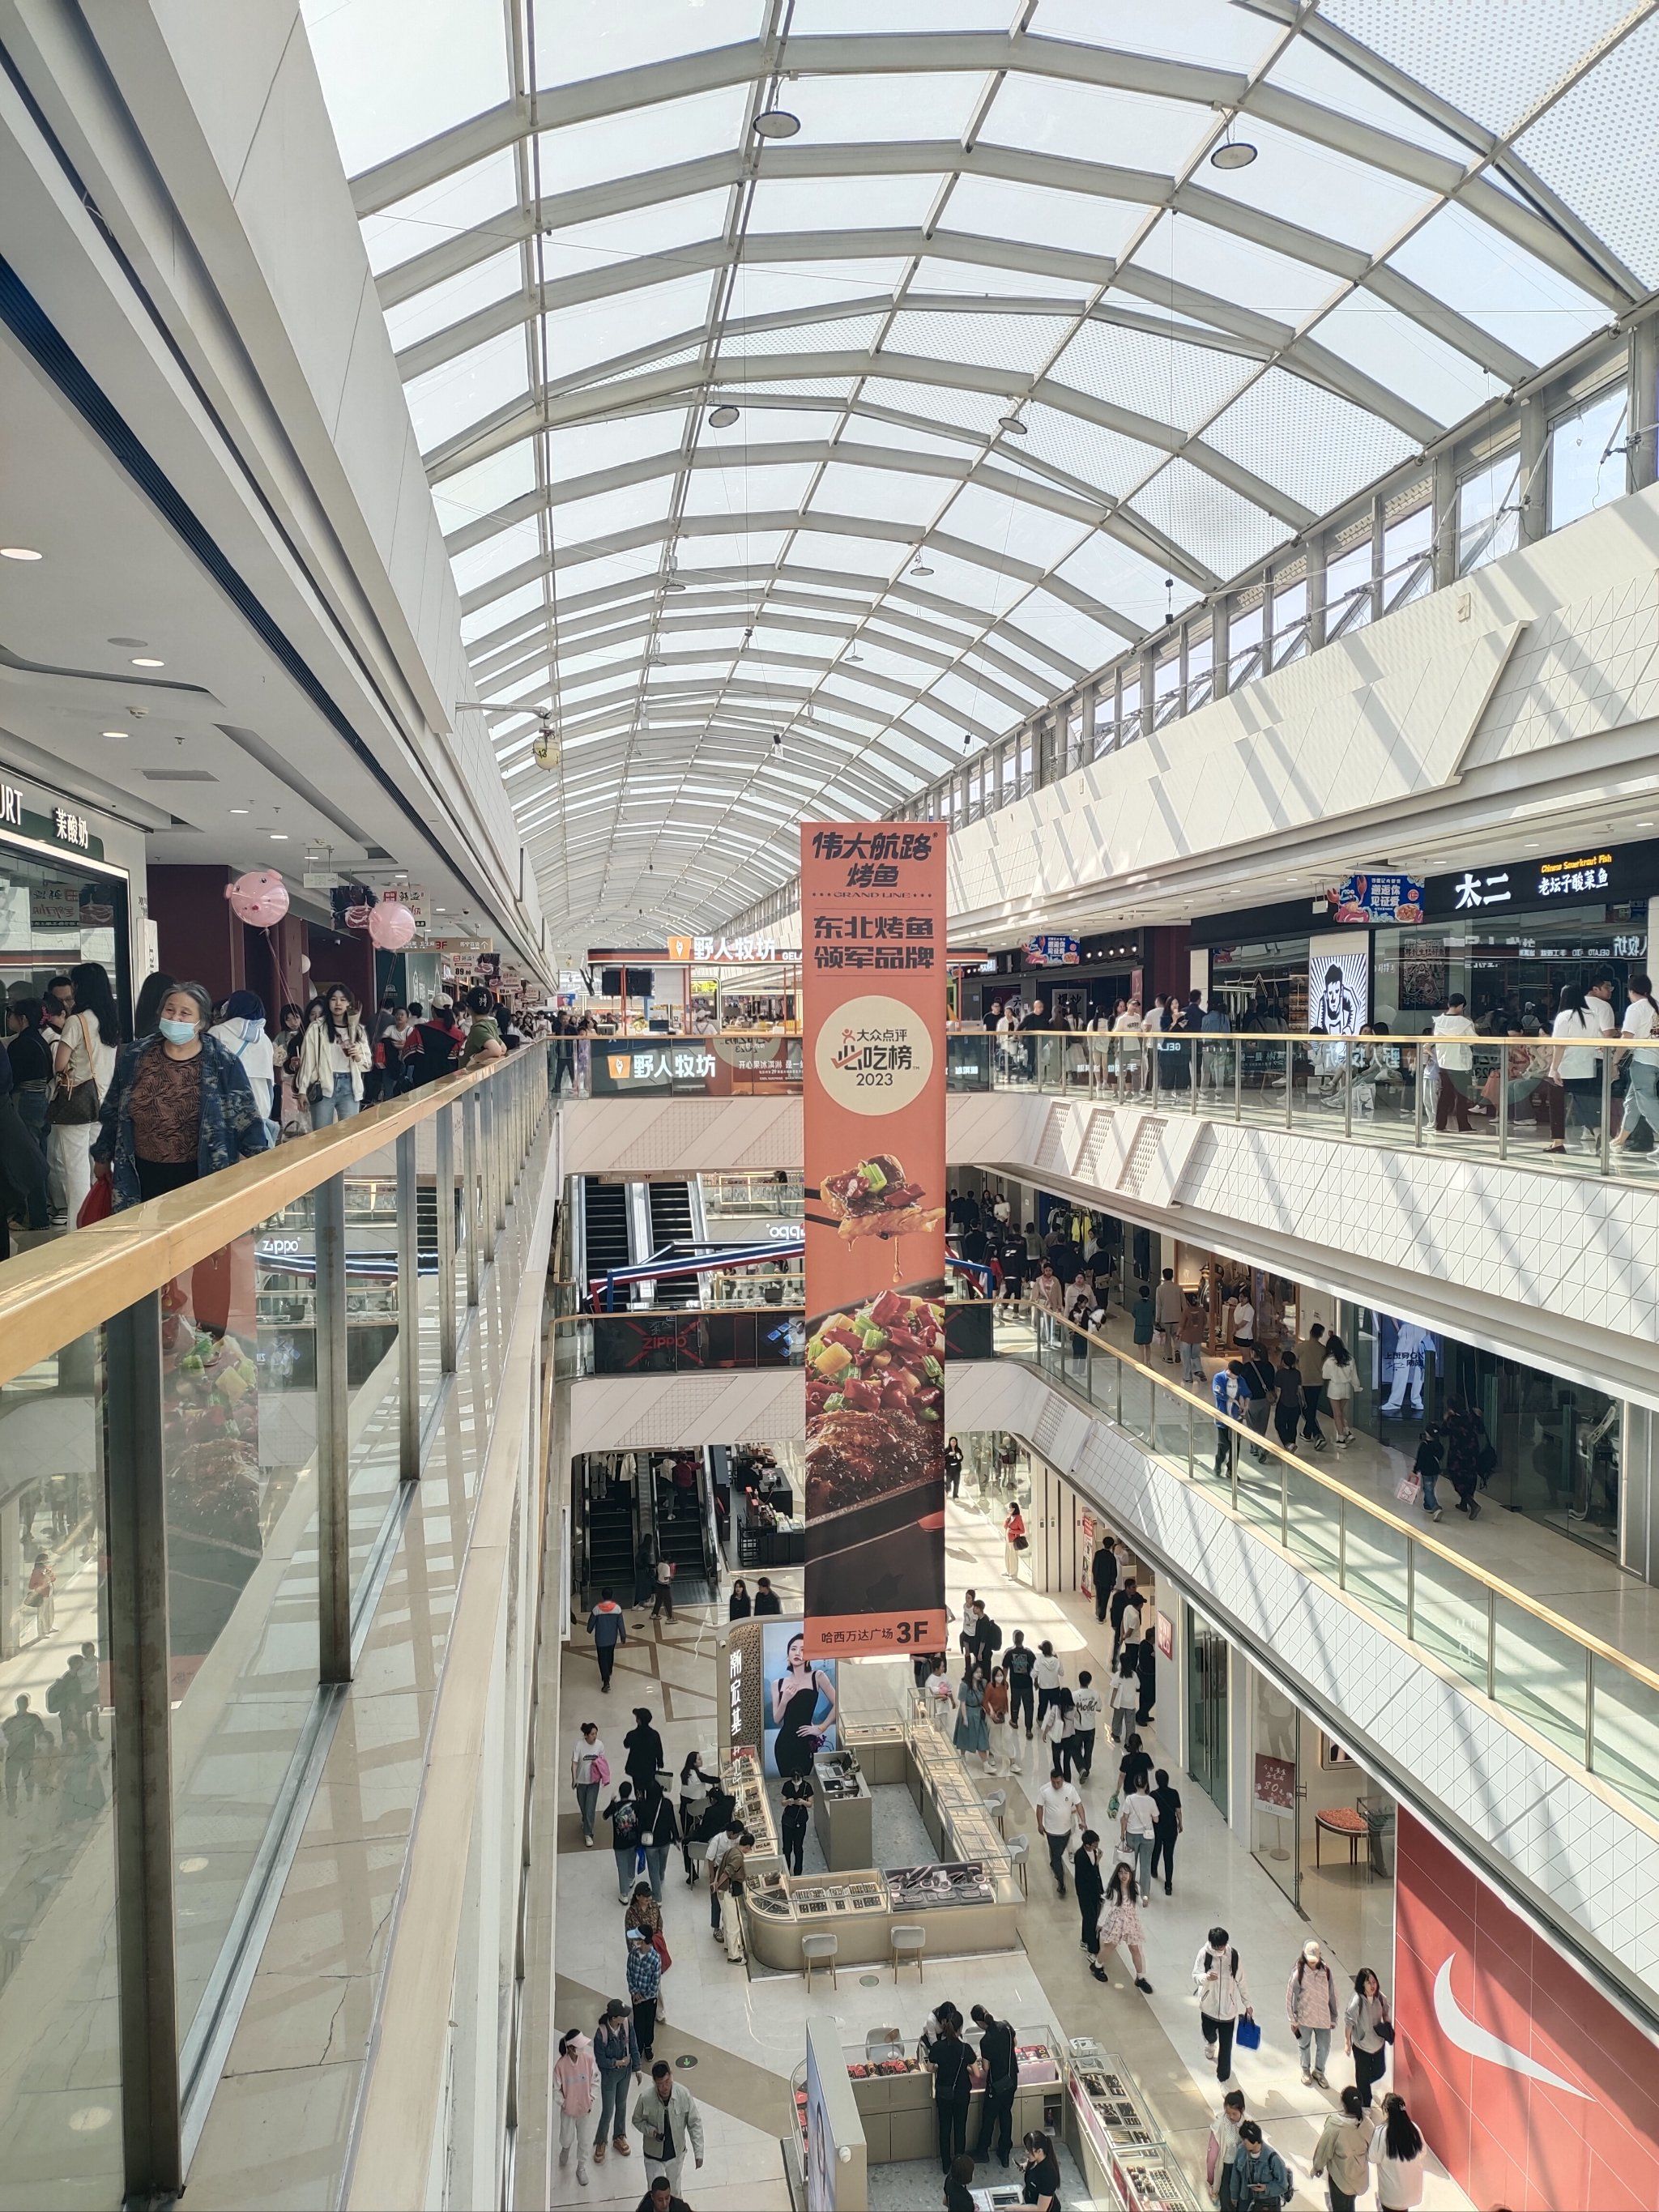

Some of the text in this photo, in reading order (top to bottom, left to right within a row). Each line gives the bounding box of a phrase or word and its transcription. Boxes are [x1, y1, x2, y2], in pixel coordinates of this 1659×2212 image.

[538, 748, 548, 759] 13
[55, 807, 89, 850] 茉酸奶
[812, 831, 932, 862] 伟大航路
[1541, 853, 1612, 873] Chinese Sauerkraut Fish
[845, 863, 899, 889] 烤鱼
[1538, 867, 1609, 896] 老坛子酸菜鱼
[1370, 895, 1401, 906] 见证爱
[1455, 872, 1512, 910] 太二
[813, 915, 935, 940] 东北烤鱼
[693, 936, 776, 961] 野人牧坊
[813, 945, 935, 970] 领军品牌
[856, 1029, 908, 1042] 大众点评
[633, 1054, 717, 1079] 野人牧坊
[830, 1045, 912, 1071] 必吃榜
[856, 1073, 893, 1086] 2023
[821, 1621, 929, 1644] 哈西万达广场 3F
